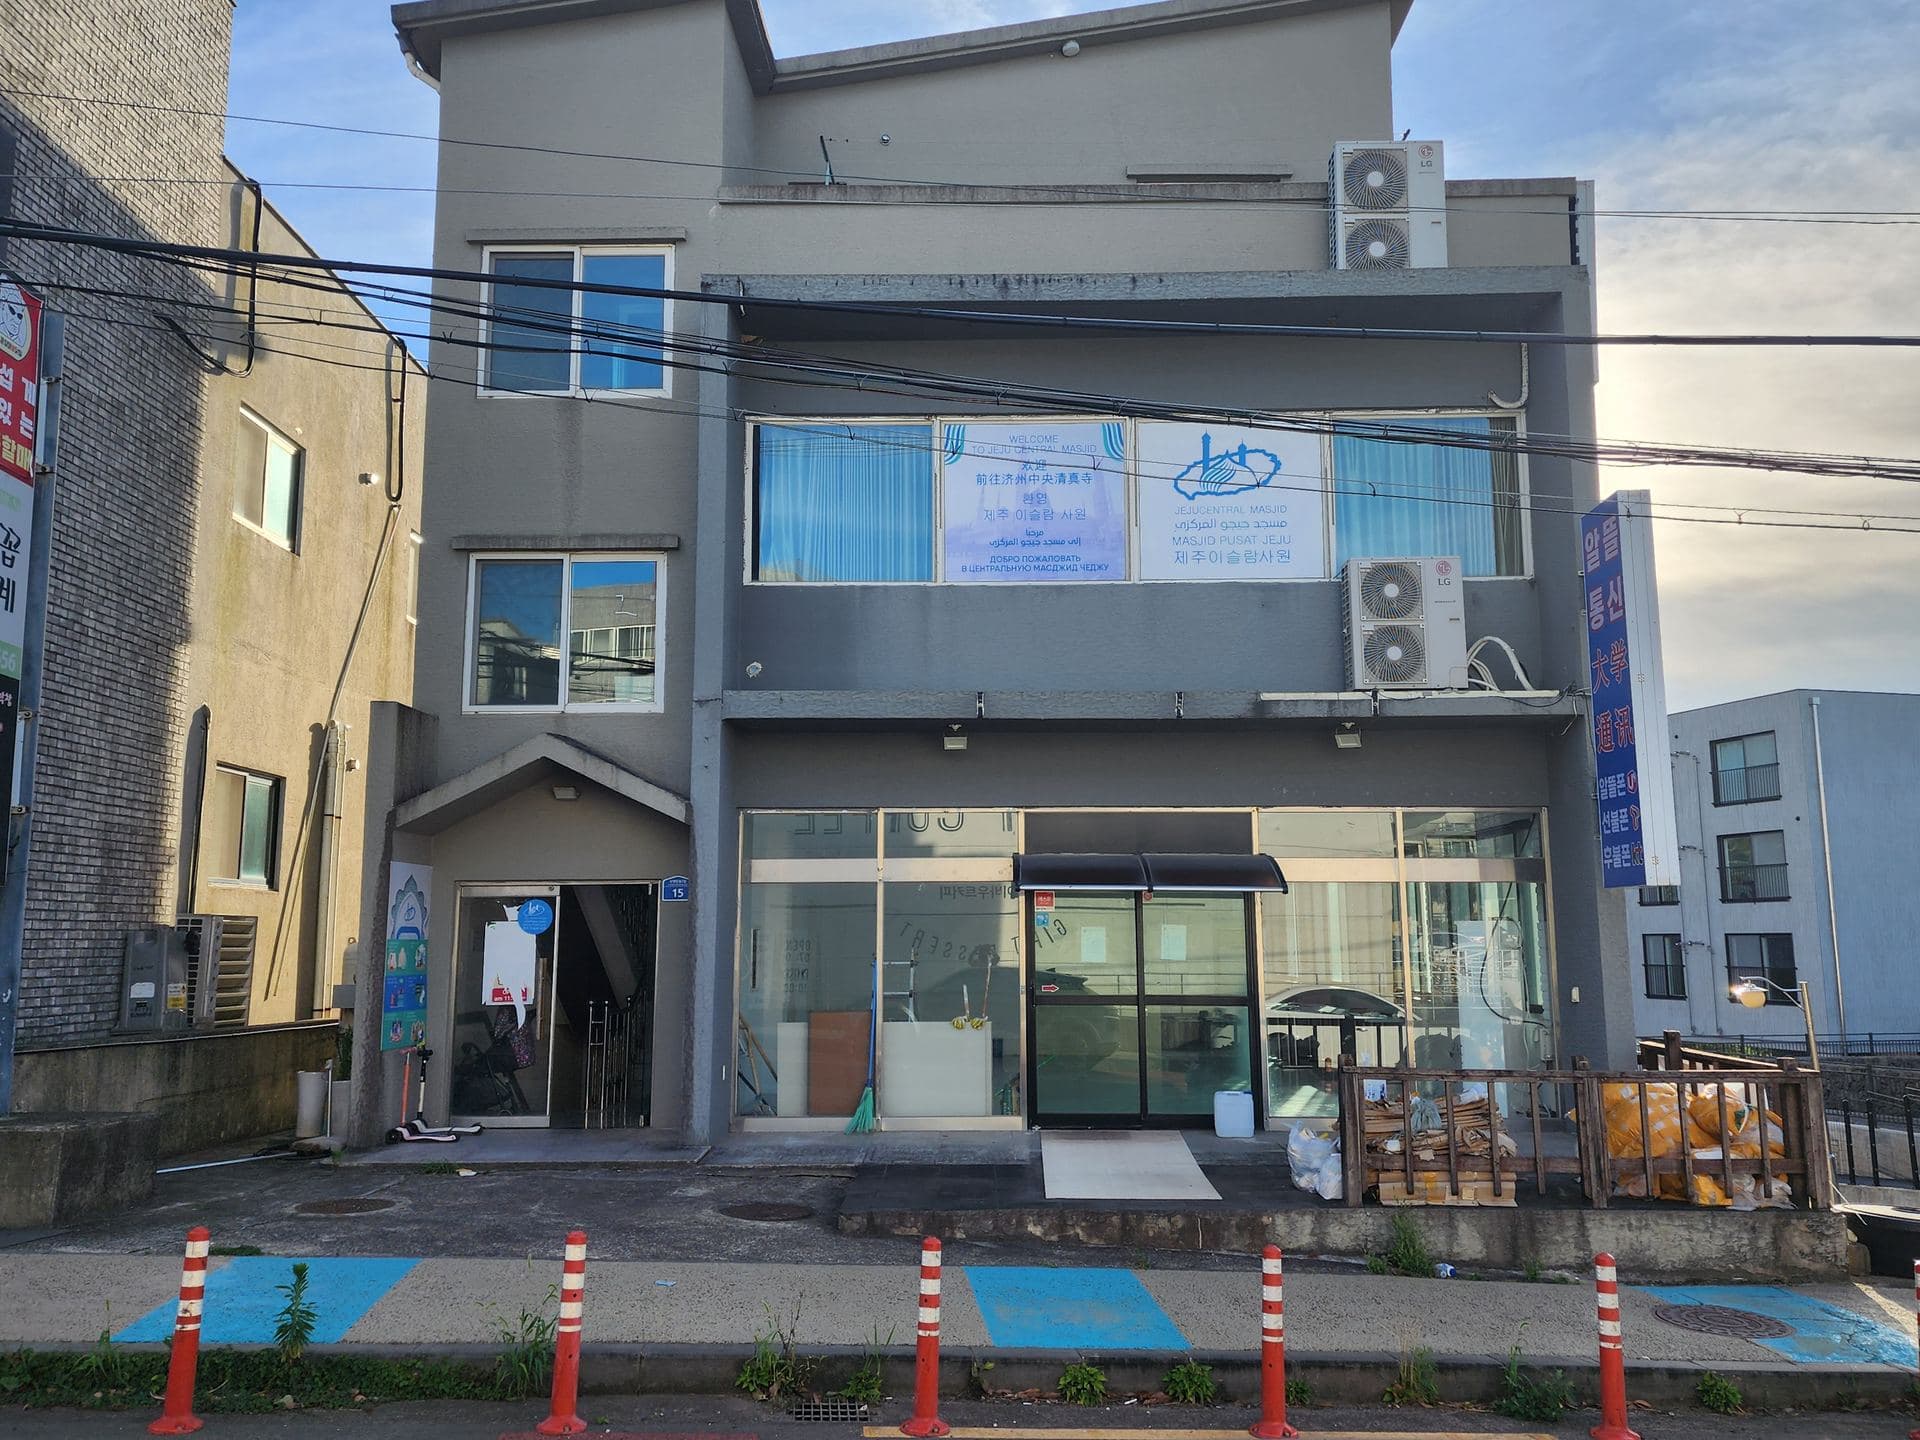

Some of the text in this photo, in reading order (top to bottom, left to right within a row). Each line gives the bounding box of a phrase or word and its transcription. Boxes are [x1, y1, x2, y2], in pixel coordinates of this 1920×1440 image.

[1420, 160, 1432, 168] LG
[1009, 434, 1058, 444] WELCOME
[972, 444, 1097, 454] TO JEJU CENTRAL MASJID
[1021, 459, 1048, 471] 欢迎
[976, 473, 1093, 486] 前往济州中央清真寺
[1022, 492, 1048, 505] 환영
[983, 508, 1087, 521] 제주 이슬람 사원
[1250, 504, 1287, 514] MASJID
[1253, 520, 1288, 530] مسجد
[1172, 535, 1292, 546] MASJID PUSAT JEJU
[1585, 516, 1619, 573] 알뜰
[990, 555, 1081, 564] ДОБРО ПОЖАЛОВАТЬ
[1174, 549, 1291, 565] 제주이슬람사원
[968, 565, 1032, 573] ЦЕНТРАЛЬНУЮ
[1033, 564, 1079, 573] МАСДЖИД
[1080, 564, 1109, 572] ЧЕДЖУ
[1438, 578, 1450, 586] LG
[1589, 575, 1624, 632] 통신
[1600, 773, 1626, 800] 알뜰폰
[1602, 807, 1629, 834] 선불폰
[1603, 843, 1631, 870] 후불폰
[672, 888, 684, 899] 15
